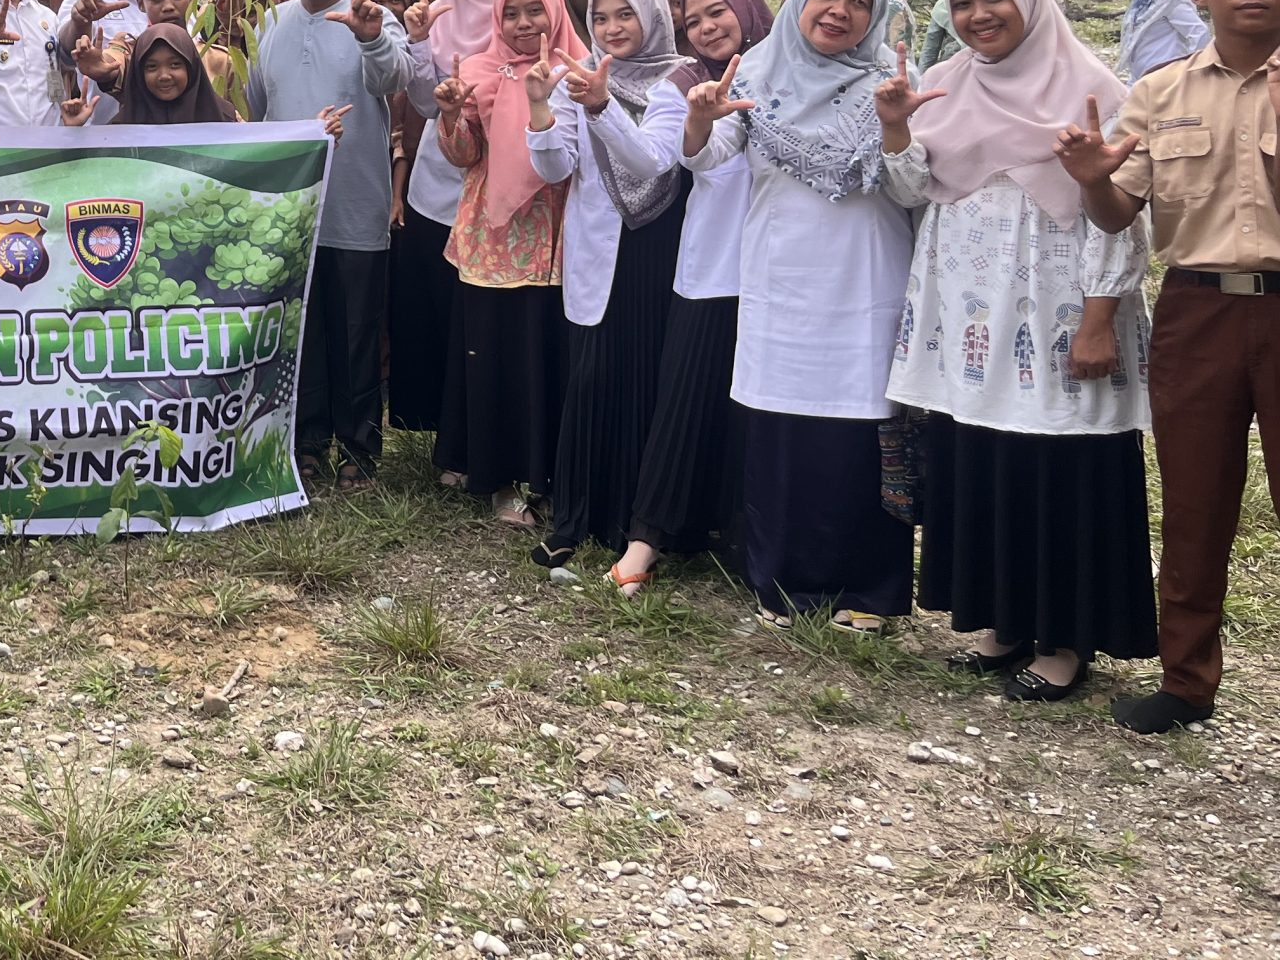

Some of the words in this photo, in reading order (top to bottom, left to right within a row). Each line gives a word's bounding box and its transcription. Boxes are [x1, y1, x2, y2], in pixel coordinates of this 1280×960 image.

[79, 203, 131, 216] BINMAS
[32, 302, 284, 378] POLICING
[29, 393, 244, 442] KUANSING
[41, 440, 234, 485] SINGINGI
